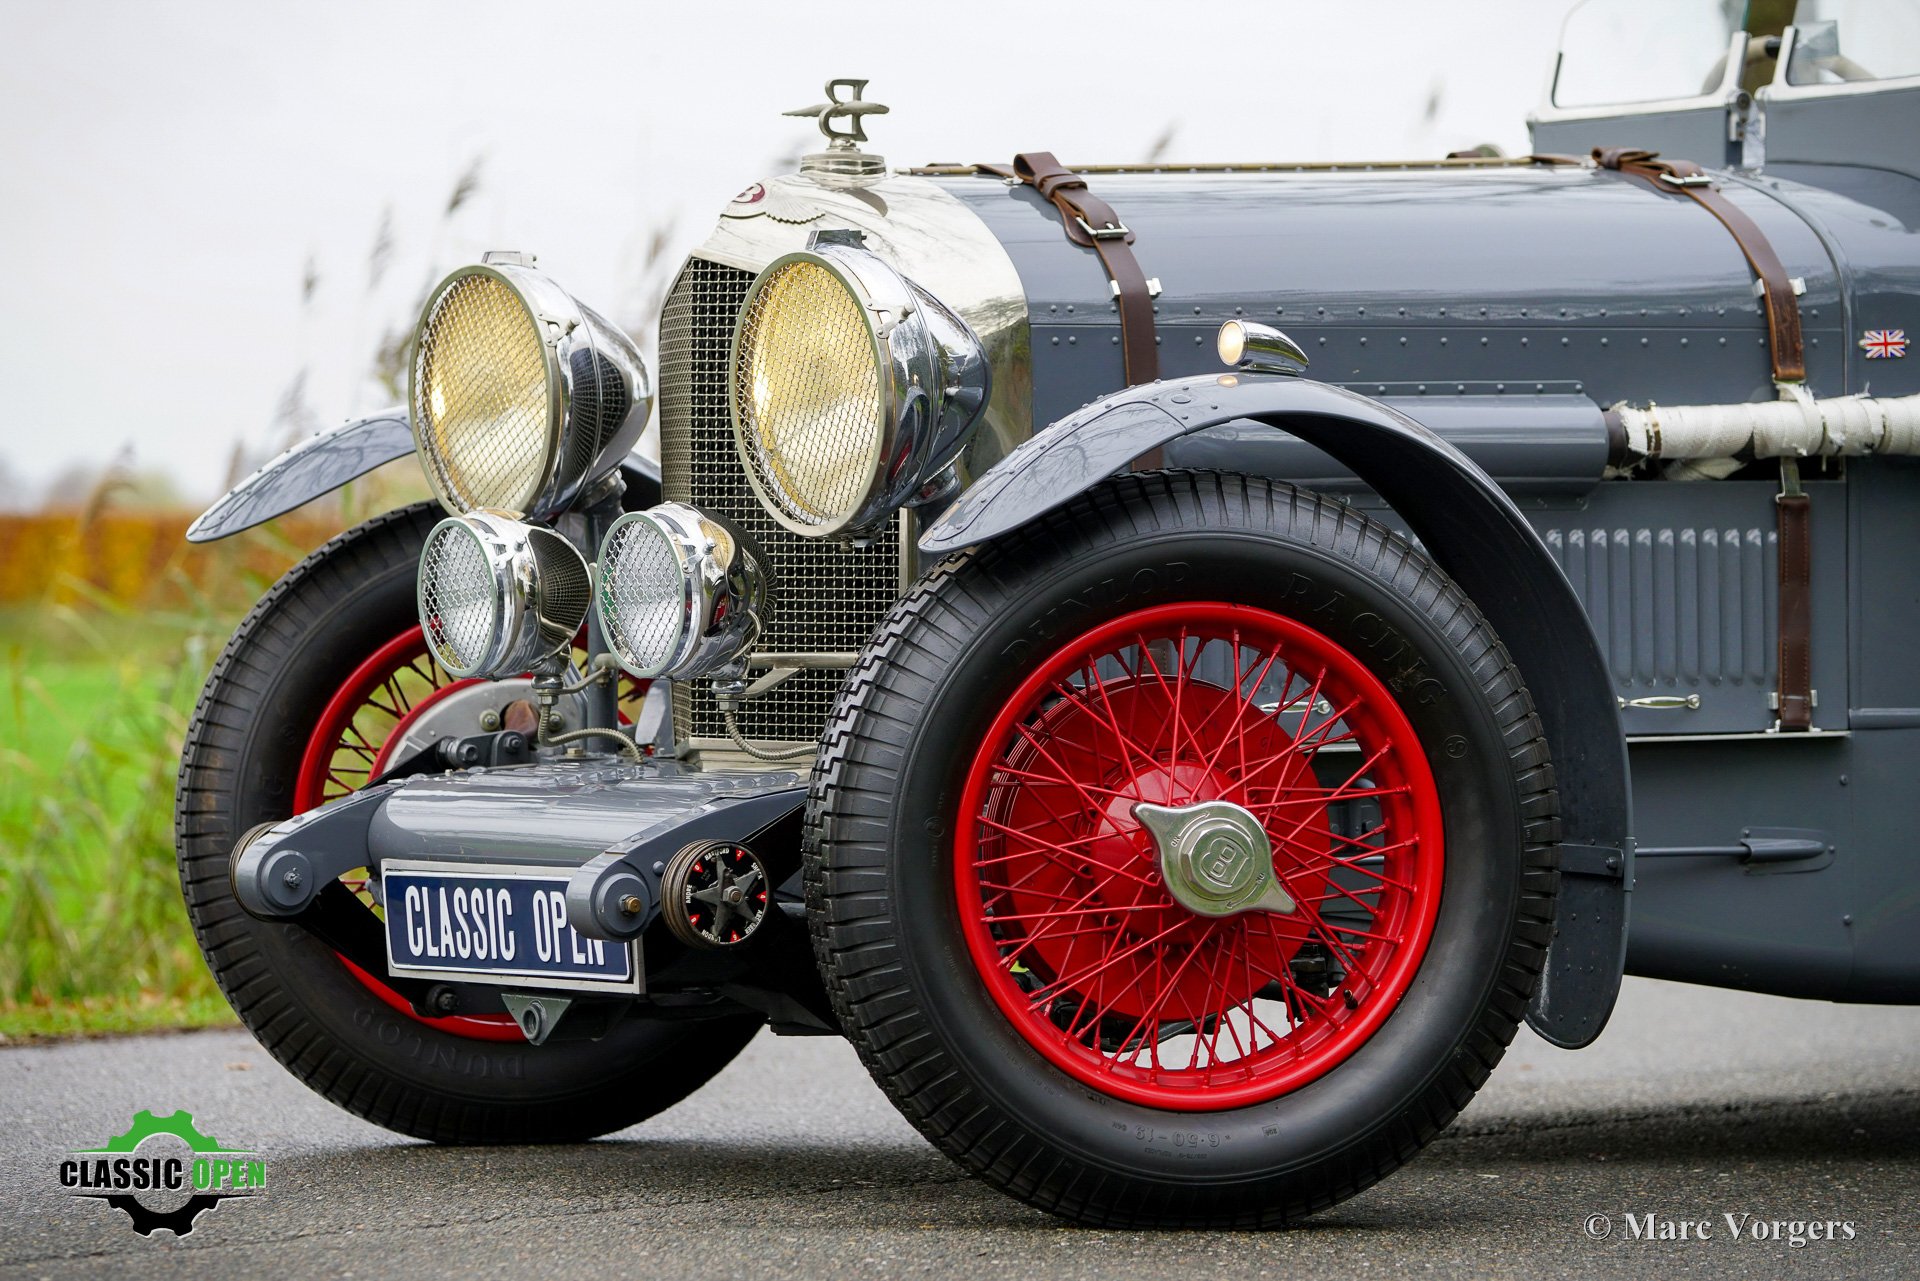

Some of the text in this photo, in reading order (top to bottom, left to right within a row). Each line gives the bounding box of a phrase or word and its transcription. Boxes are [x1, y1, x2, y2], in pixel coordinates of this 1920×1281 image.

[1001, 561, 1193, 667] DUNLOP
[1281, 571, 1448, 707] RACING
[405, 885, 516, 962] CLASSIC
